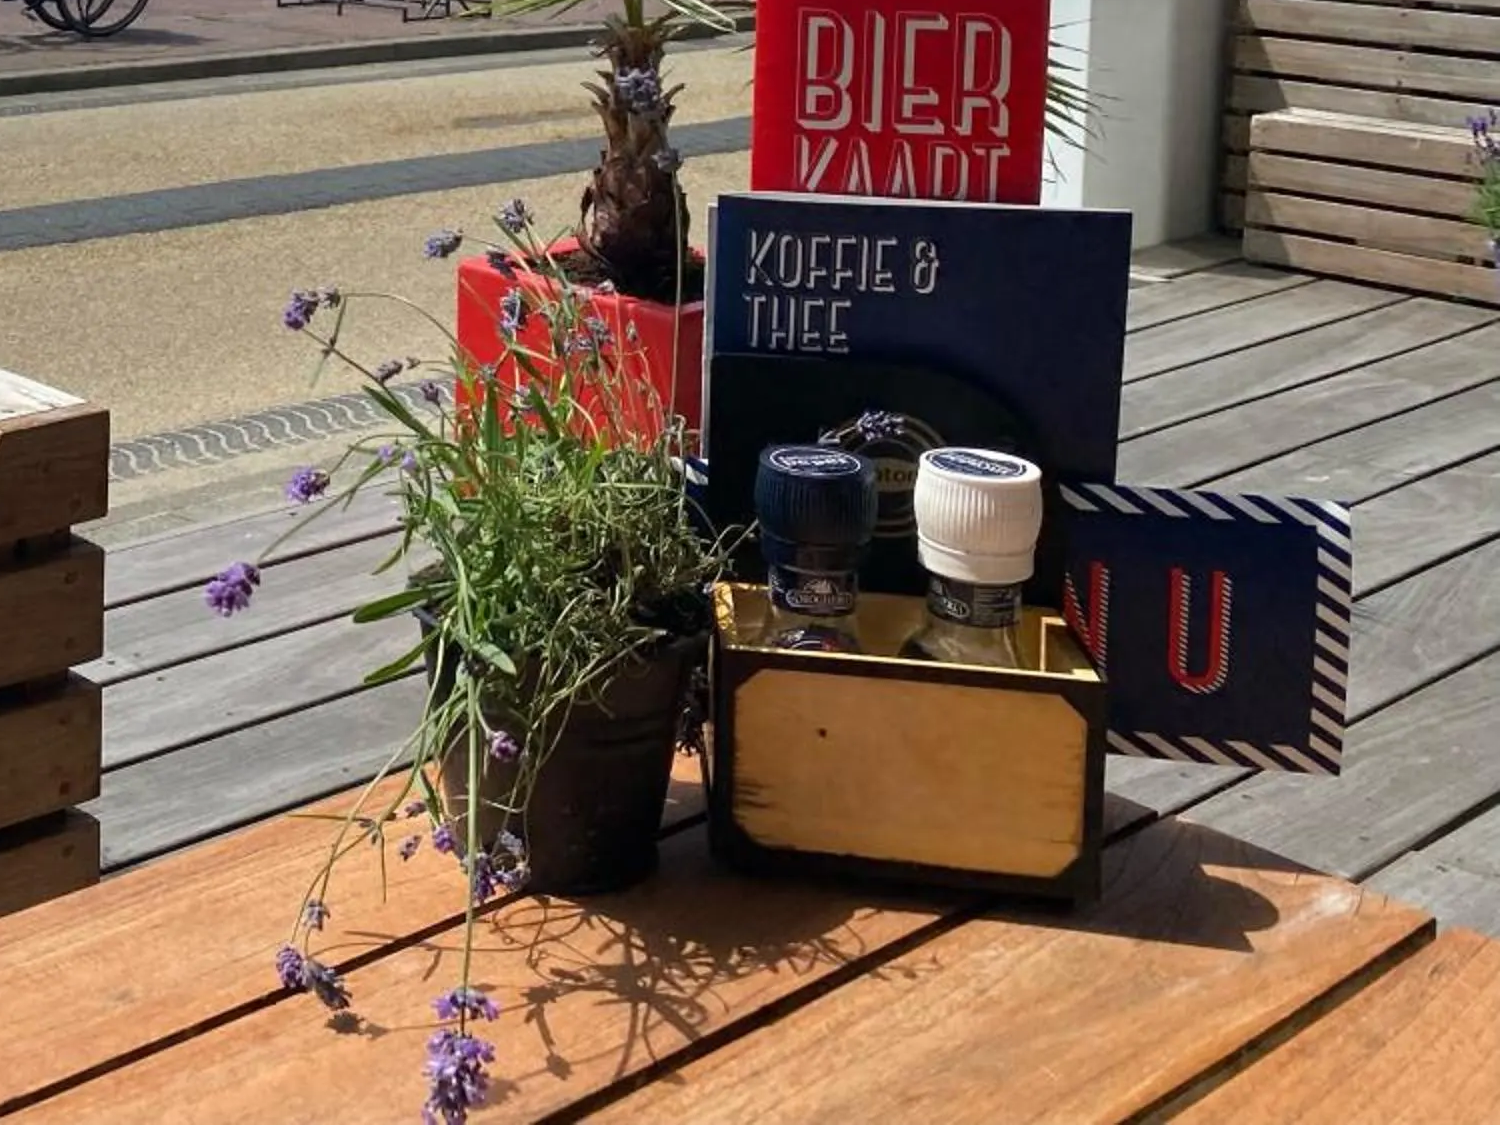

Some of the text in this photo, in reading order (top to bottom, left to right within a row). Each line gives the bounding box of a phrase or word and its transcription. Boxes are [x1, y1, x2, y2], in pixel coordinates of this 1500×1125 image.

[795, 6, 1012, 137] BIER
[746, 229, 940, 294] KOFFIE &
[742, 292, 852, 354] THEE
